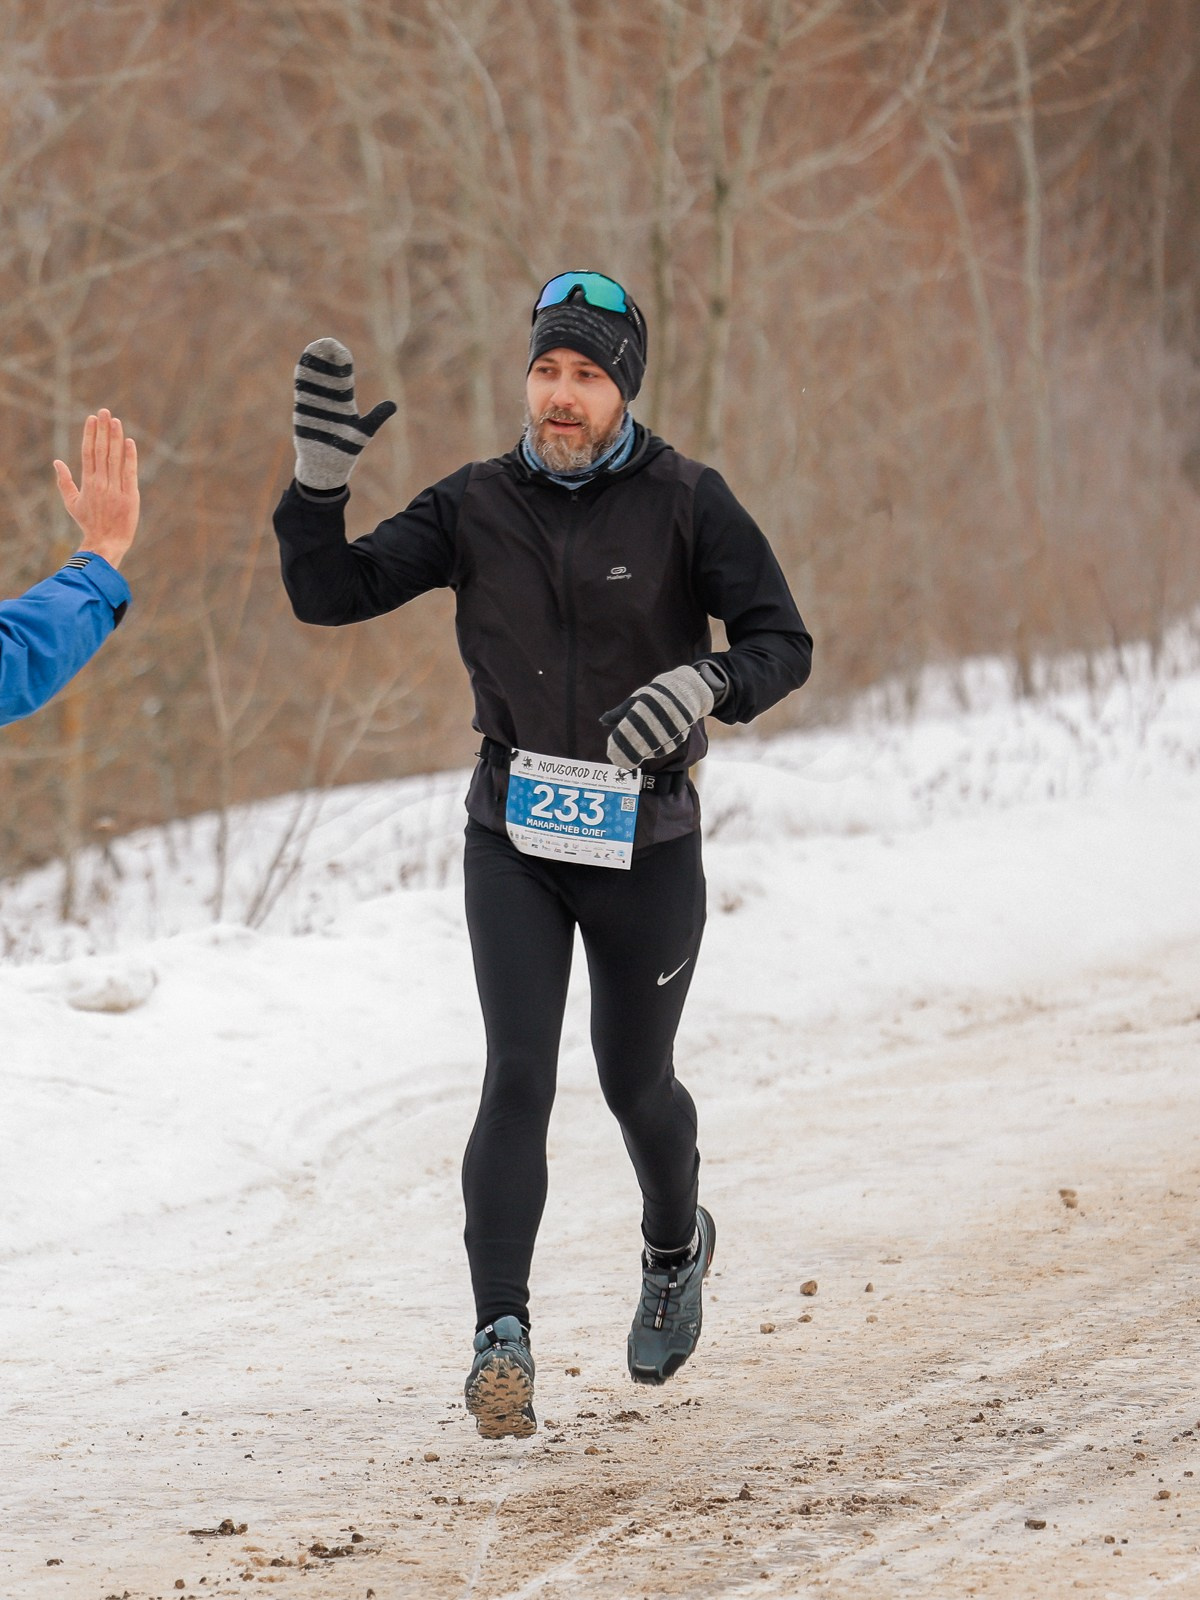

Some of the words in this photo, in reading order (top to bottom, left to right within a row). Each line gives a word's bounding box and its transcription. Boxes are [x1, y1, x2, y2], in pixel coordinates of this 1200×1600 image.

[538, 760, 590, 779] NOVGOROD
[592, 769, 608, 782] ICE
[531, 784, 606, 826] 233
[526, 817, 580, 834] МАКАРЫЧЕВ
[581, 827, 607, 837] ОЛЕГ
